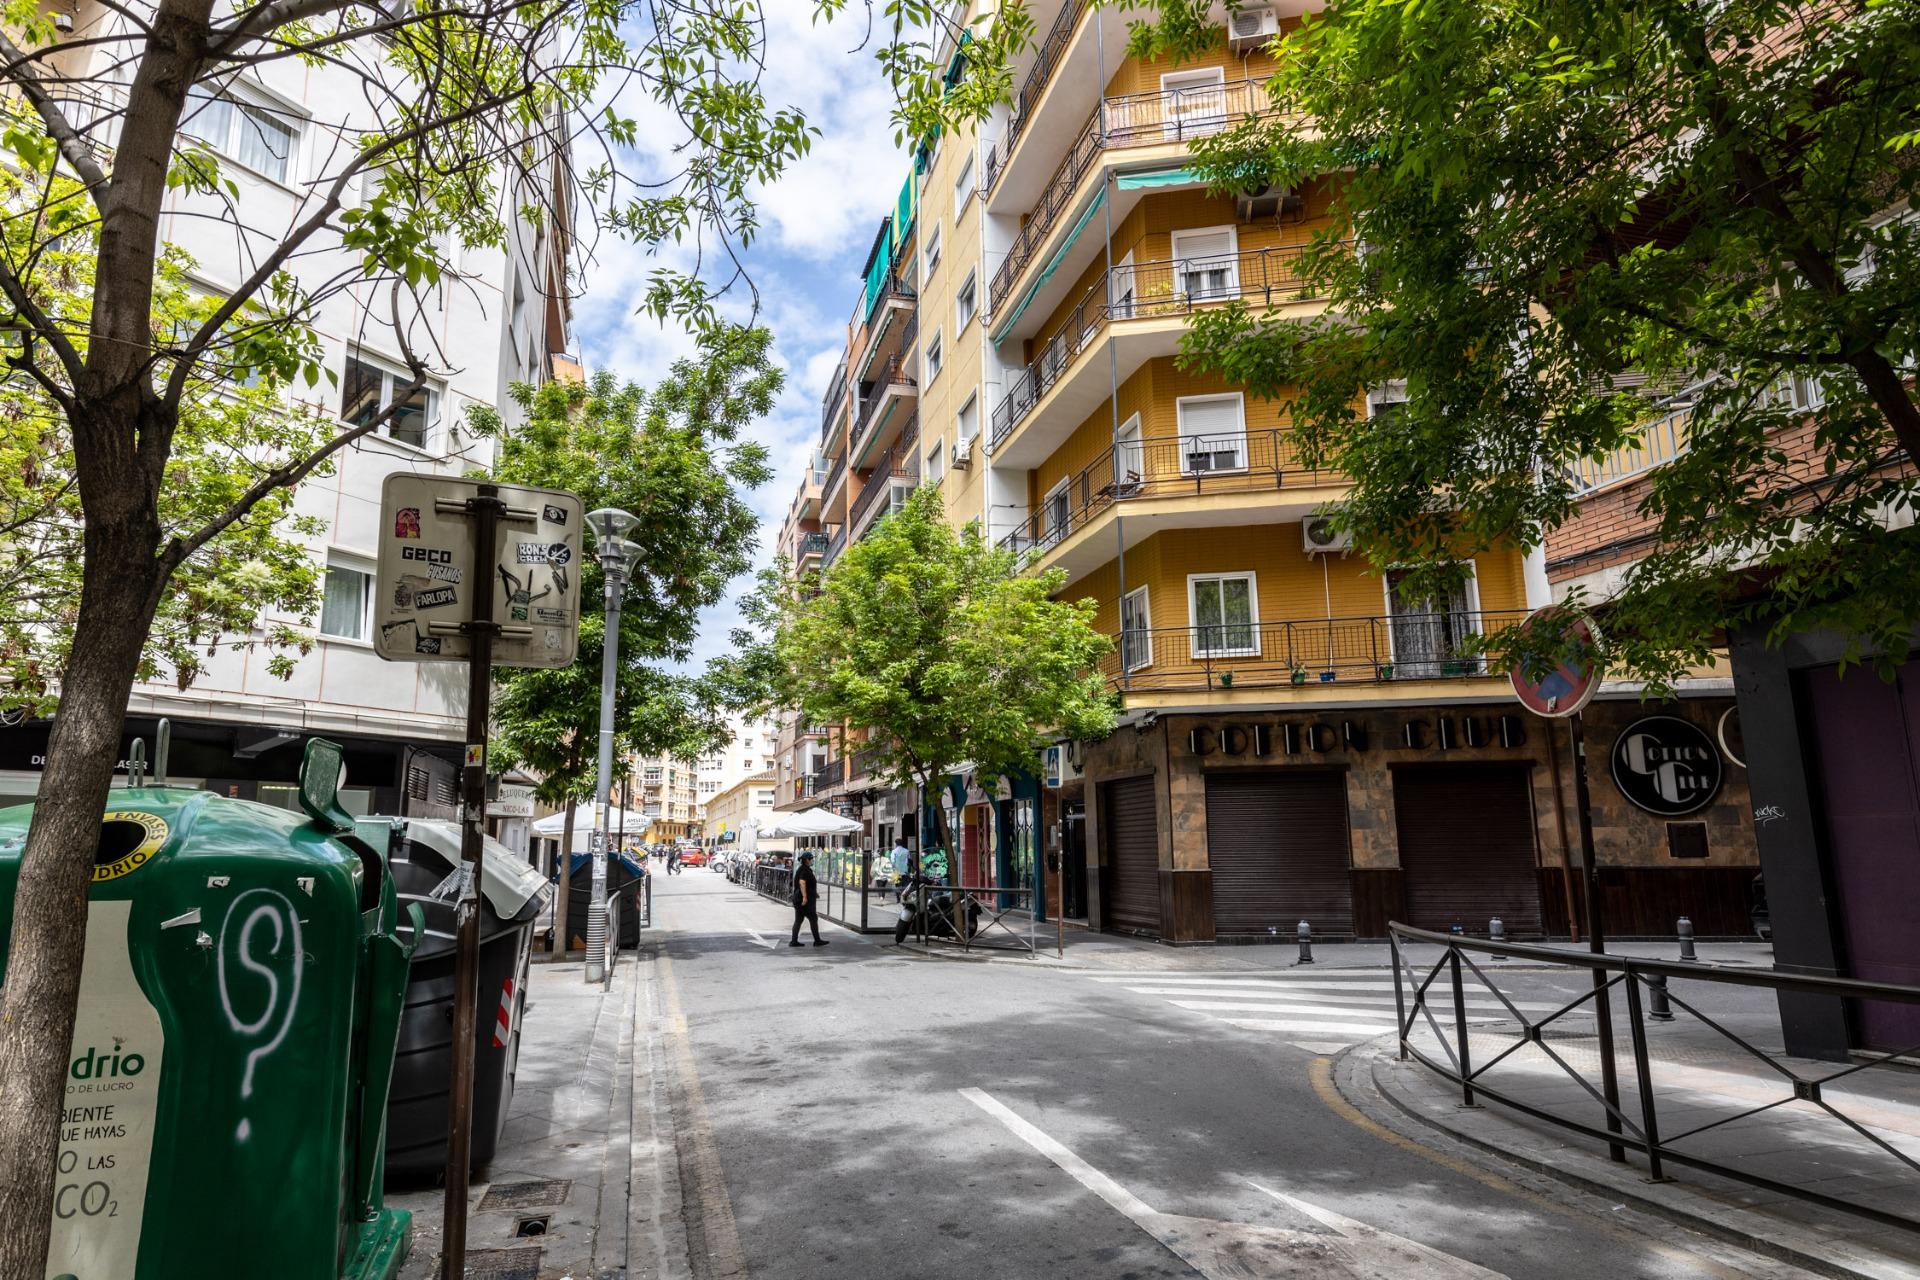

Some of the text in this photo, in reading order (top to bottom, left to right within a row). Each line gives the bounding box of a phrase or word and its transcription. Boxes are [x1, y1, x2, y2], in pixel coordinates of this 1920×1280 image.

[427, 564, 462, 584] GUSANOS
[416, 589, 455, 606] FARLOPA
[1188, 715, 1527, 756] COTTON CLUB
[1622, 734, 1708, 775] COTTON
[114, 760, 148, 770] ASER
[1653, 761, 1711, 803] CLUB
[115, 812, 165, 840] ENVASES
[92, 852, 146, 879] IDRIO
[78, 1084, 93, 1093] DE
[96, 1081, 134, 1092] LUCRO
[84, 1125, 126, 1140] HAYAS
[87, 1155, 115, 1170] LAS
